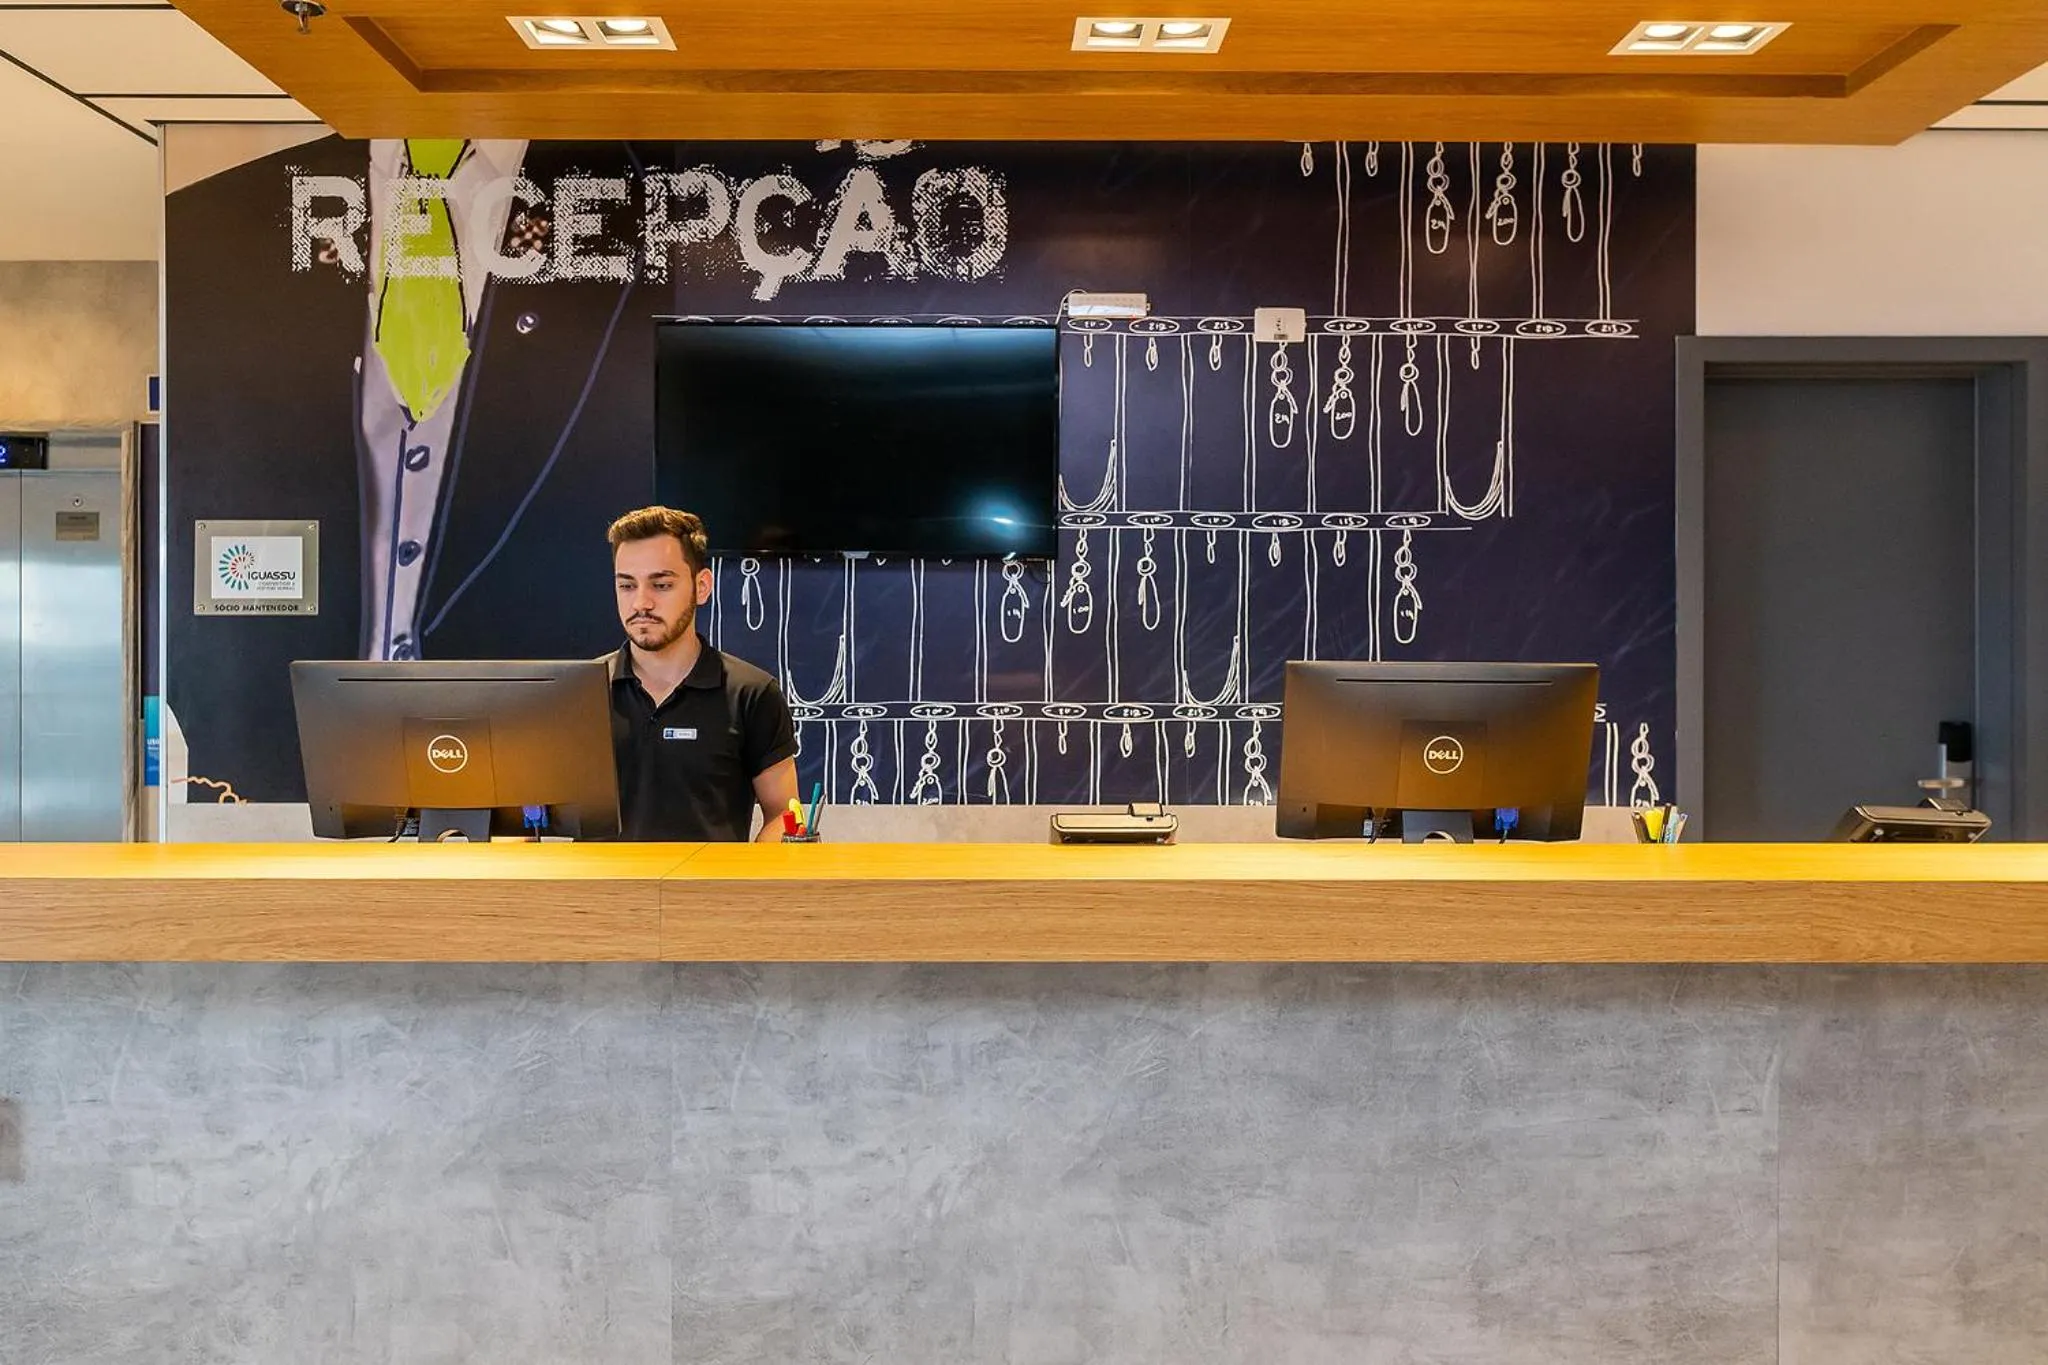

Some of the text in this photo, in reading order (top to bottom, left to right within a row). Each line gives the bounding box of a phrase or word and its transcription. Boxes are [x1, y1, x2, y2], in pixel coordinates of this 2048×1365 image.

[247, 571, 296, 581] IGUASSU
[432, 749, 464, 759] DELL
[1428, 750, 1459, 760] DELL
